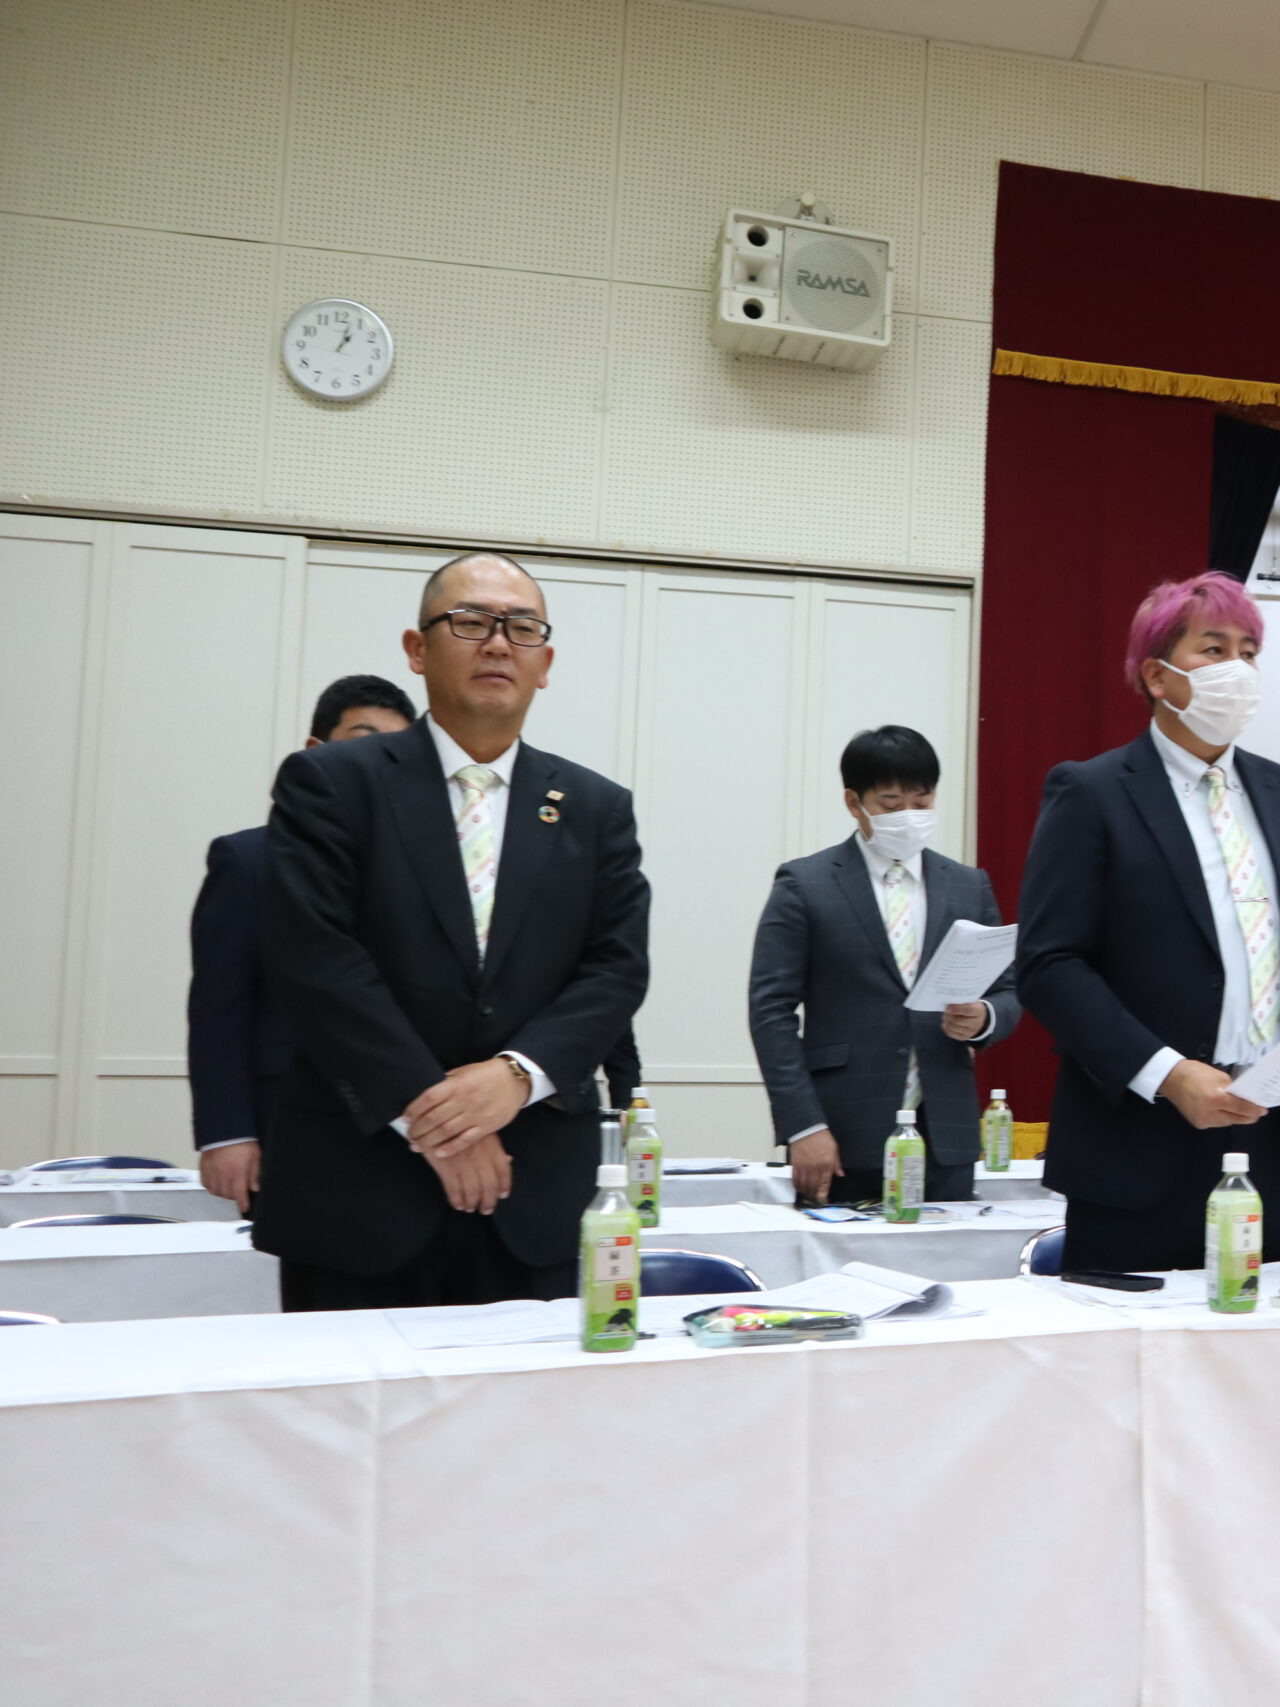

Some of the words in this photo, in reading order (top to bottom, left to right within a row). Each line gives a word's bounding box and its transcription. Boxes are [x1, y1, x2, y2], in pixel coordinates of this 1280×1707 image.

[796, 269, 871, 298] RAMSA
[317, 314, 328, 326] 11
[334, 311, 349, 324] 12
[357, 318, 363, 330] 1
[302, 325, 317, 337] 10
[366, 330, 377, 343] 2
[296, 340, 306, 352] 9
[370, 348, 381, 361] 3
[331, 378, 341, 389] 6
